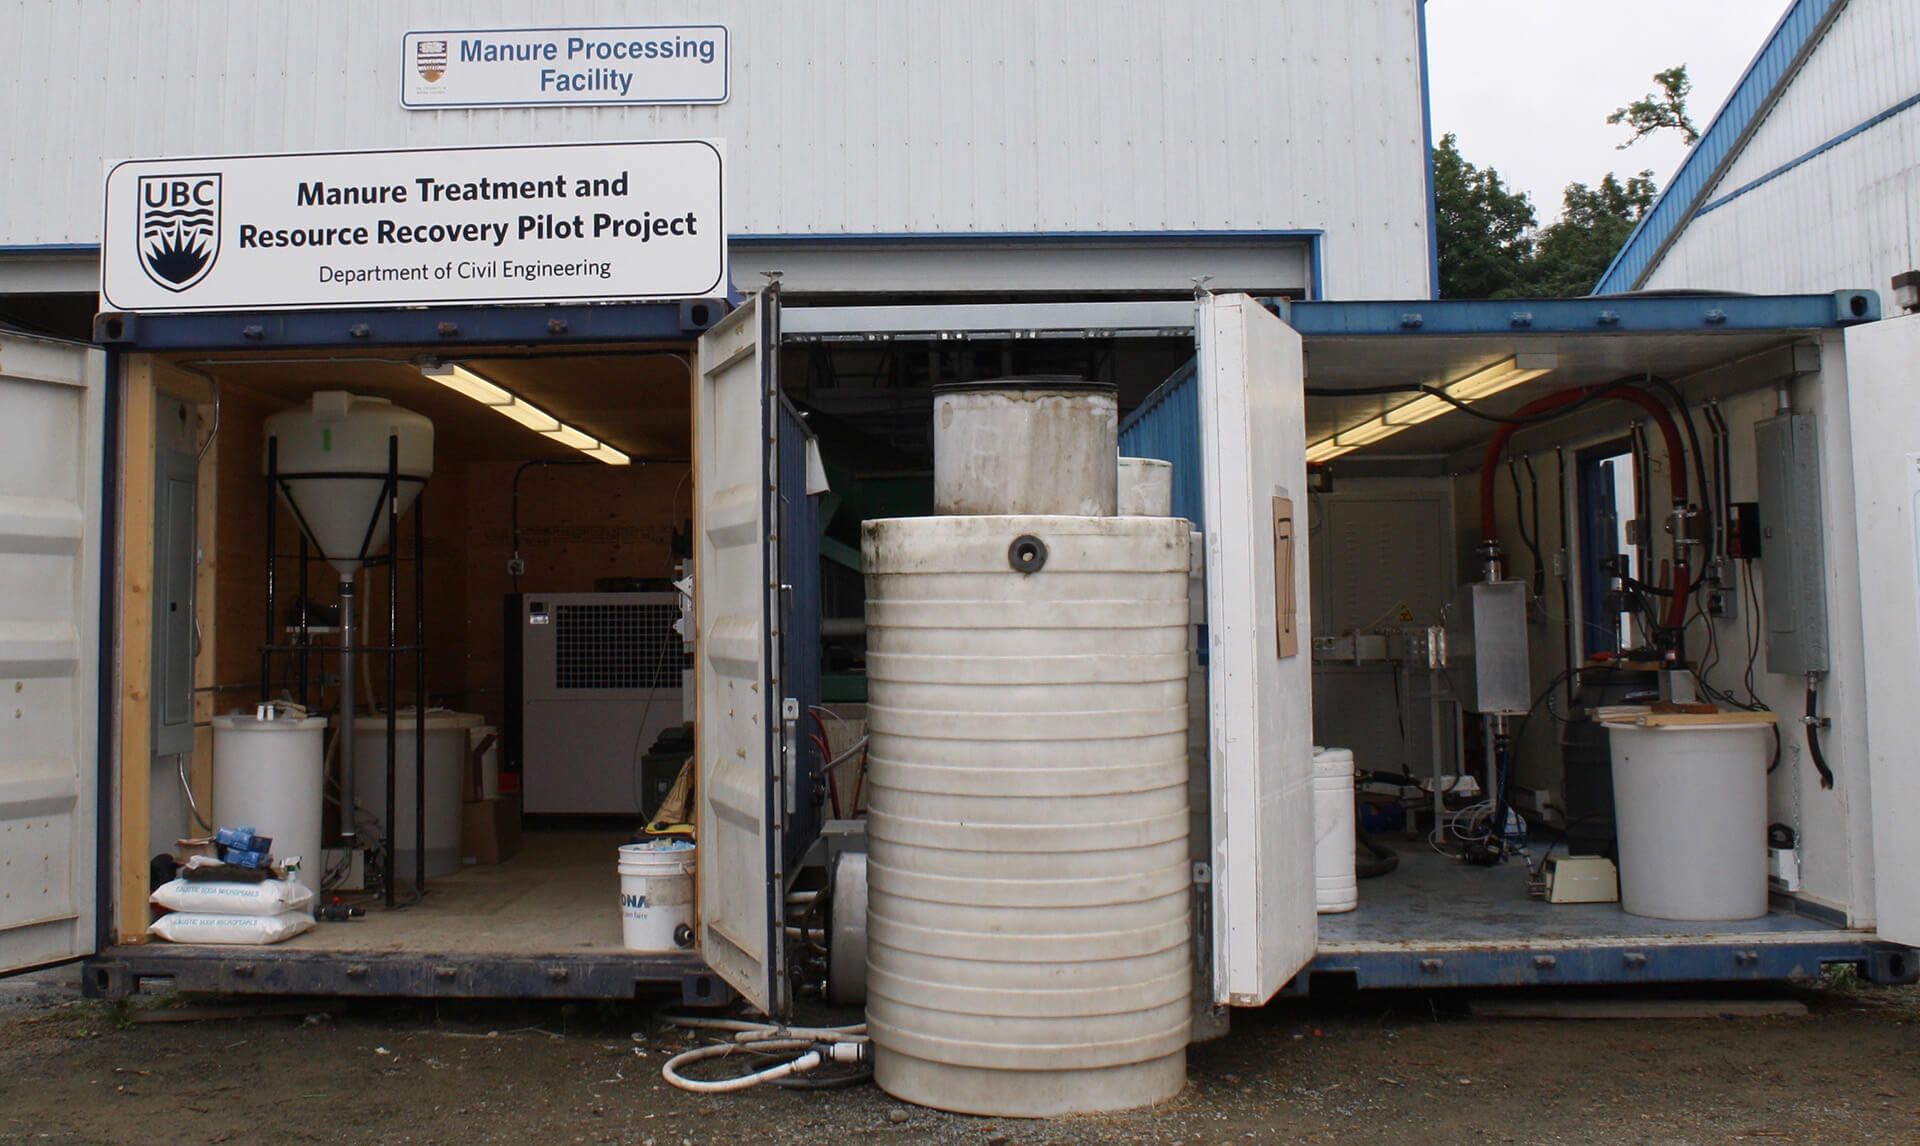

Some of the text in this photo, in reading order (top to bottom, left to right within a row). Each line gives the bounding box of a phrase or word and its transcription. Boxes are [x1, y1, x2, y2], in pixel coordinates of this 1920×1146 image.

[460, 35, 715, 64] Manure Processing
[541, 68, 633, 97] Facility
[145, 180, 214, 208] UBC
[297, 171, 628, 207] Manure Treatment and
[239, 211, 697, 249] Resource Recovery Pilot Project
[319, 260, 611, 286] Department of Civil Engineering
